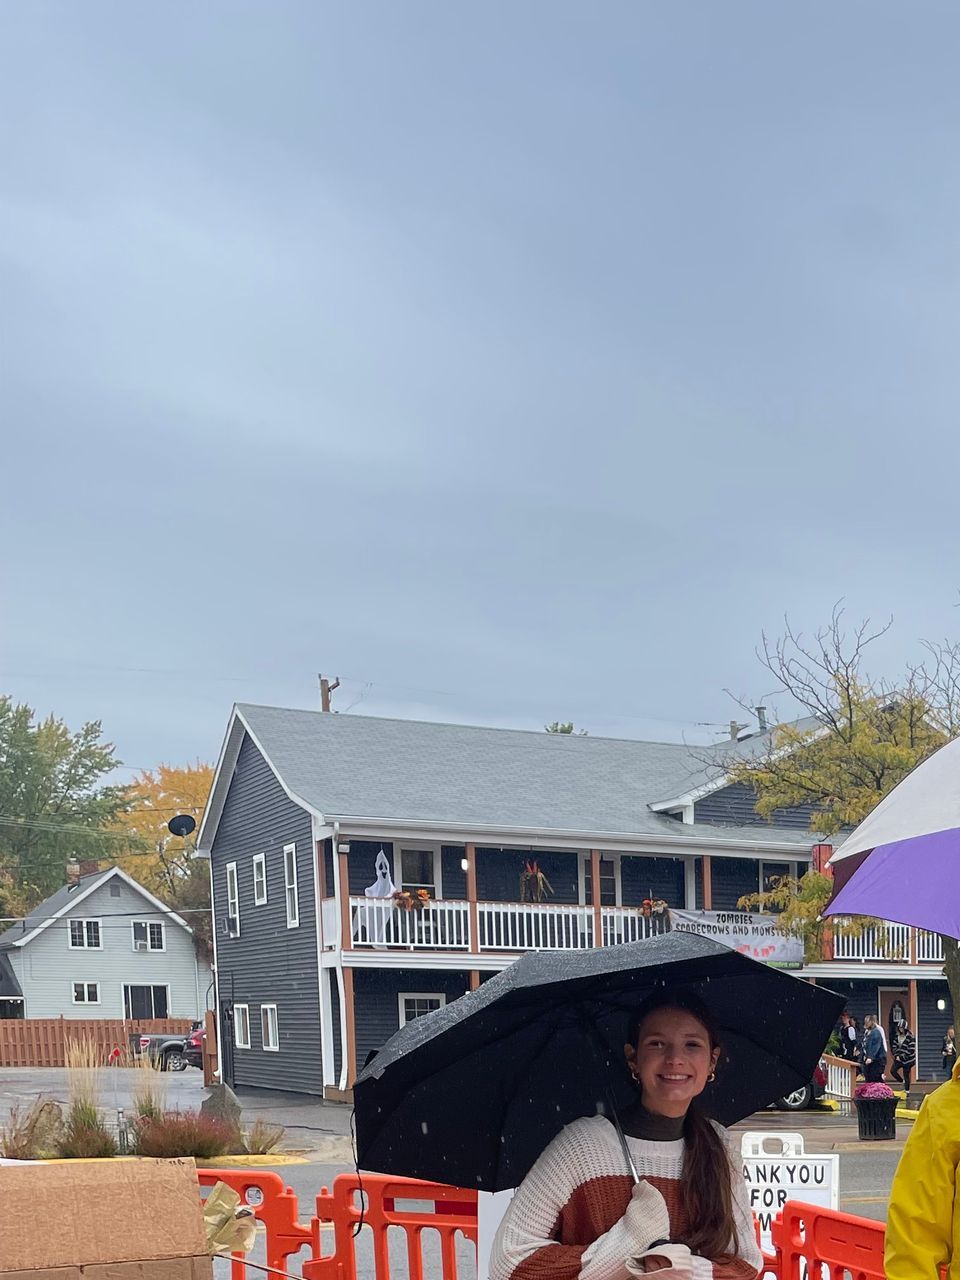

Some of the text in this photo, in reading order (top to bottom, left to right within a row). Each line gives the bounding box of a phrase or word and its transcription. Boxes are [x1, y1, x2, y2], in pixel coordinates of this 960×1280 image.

[716, 913, 753, 925] ZOMBIES
[733, 926, 749, 936] AND
[743, 1165, 825, 1185] ANK YOU
[750, 1188, 788, 1208] FOR
